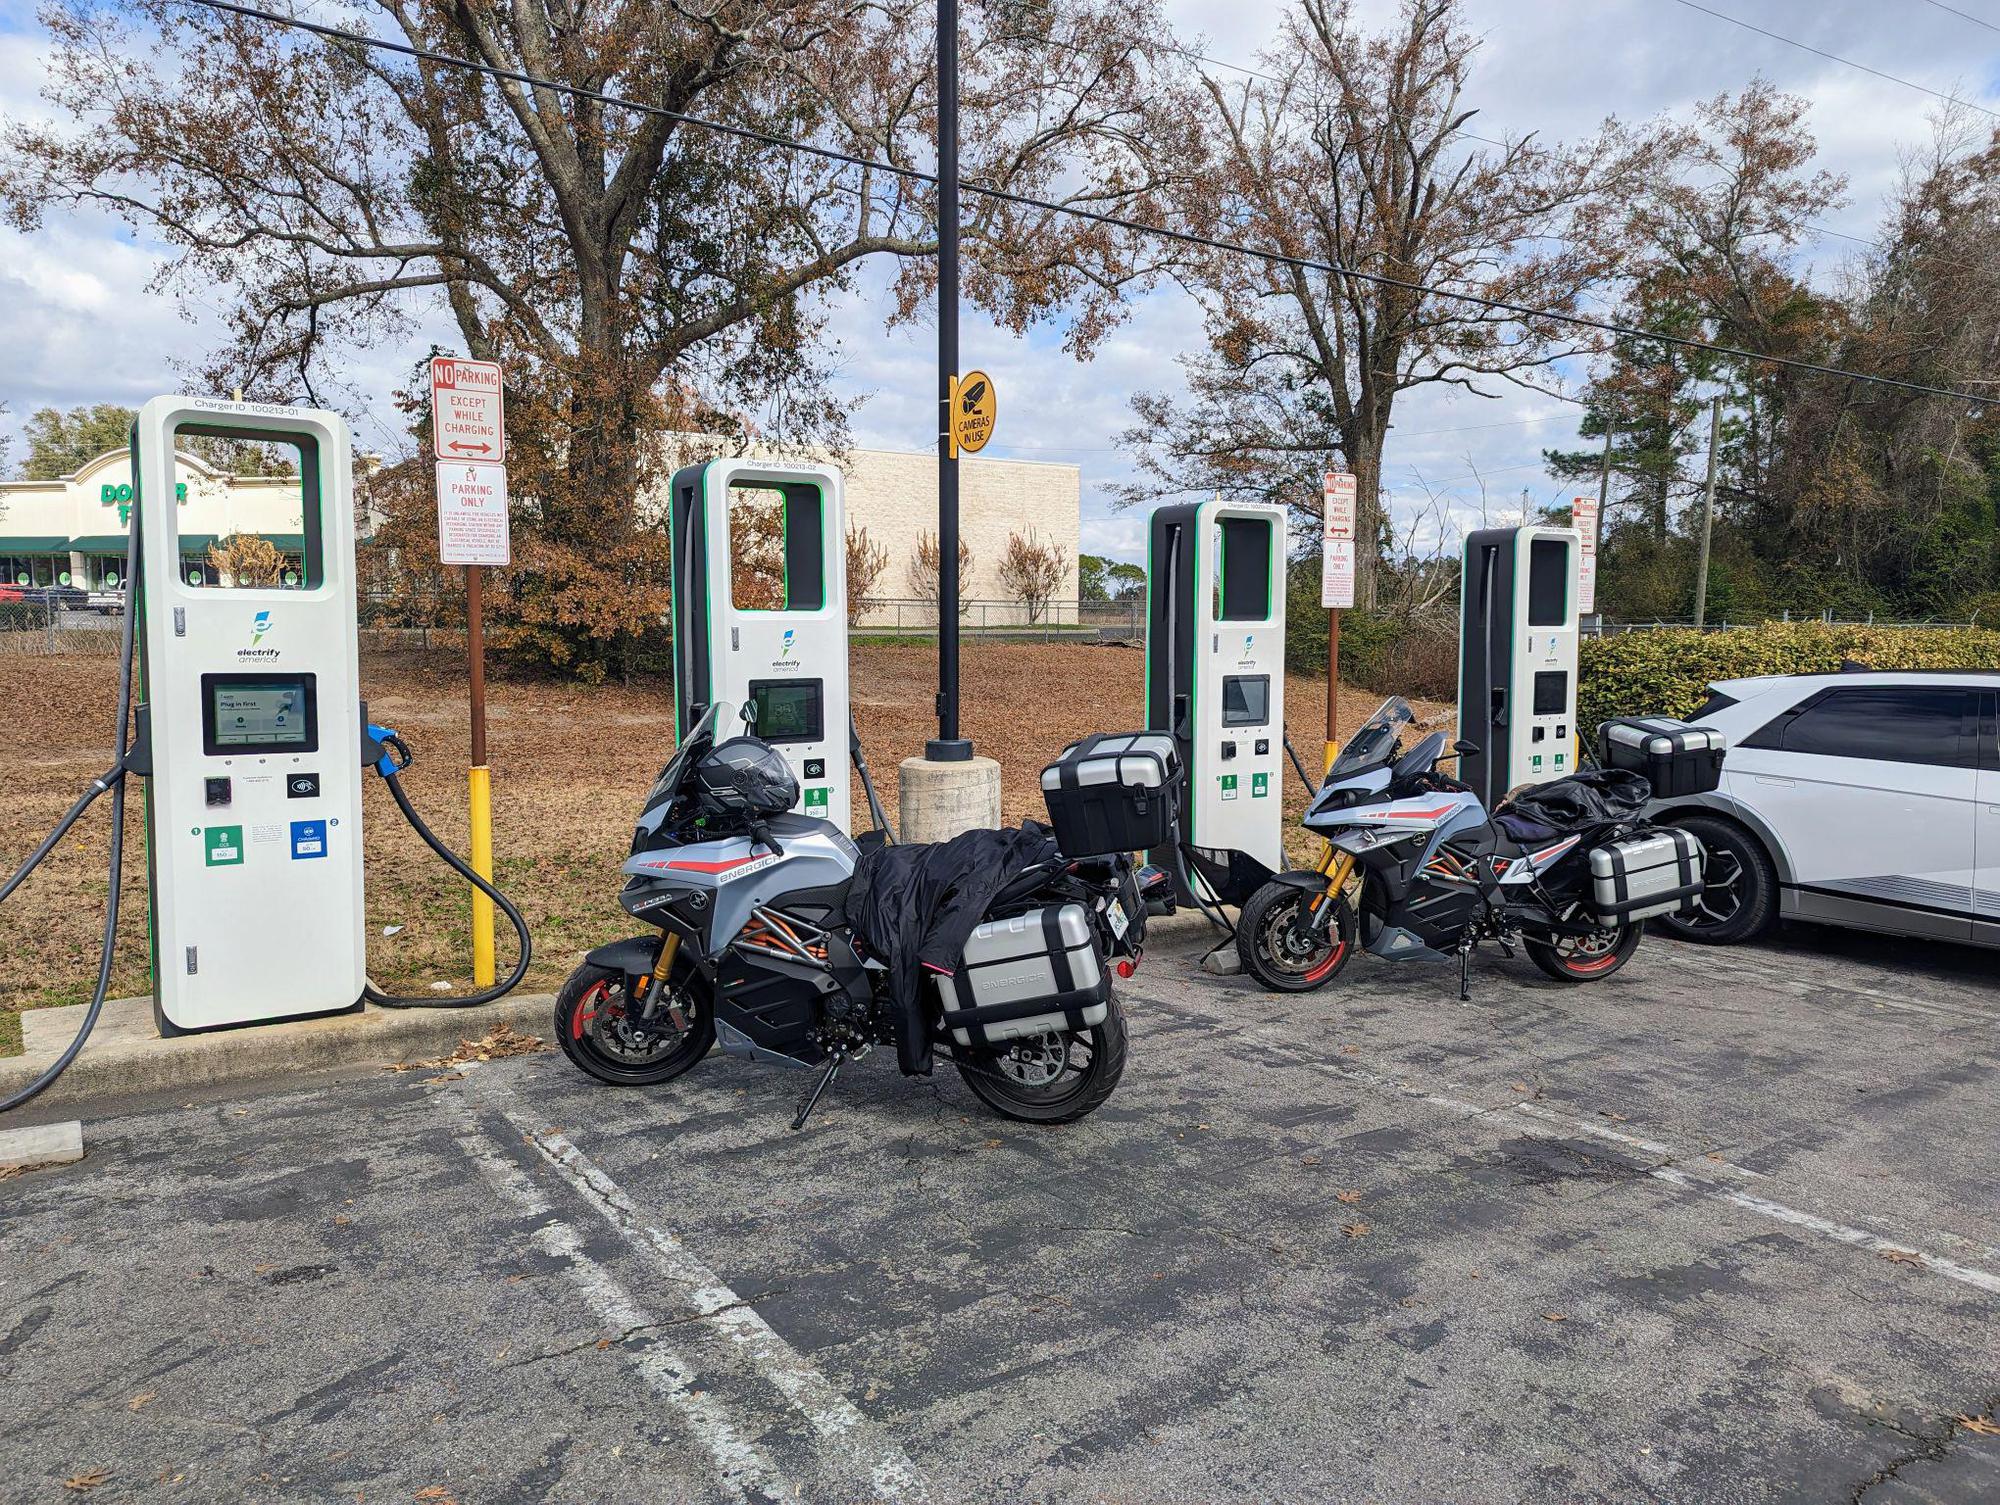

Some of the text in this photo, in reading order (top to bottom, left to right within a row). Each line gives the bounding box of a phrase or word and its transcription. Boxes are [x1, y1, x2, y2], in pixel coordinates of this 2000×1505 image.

[434, 364, 497, 386] NO PARKING
[194, 399, 299, 416] Charger ID 100213-01
[450, 395, 486, 409] EXCEPT
[454, 409, 484, 422] WHILE
[445, 422, 494, 436] CHARGING
[958, 415, 990, 432] CAMERAS
[964, 430, 984, 444] IN USE
[465, 471, 477, 482] EV
[452, 483, 493, 496] PARKING
[461, 496, 485, 508] ONLY
[237, 648, 280, 658] electrify
[771, 660, 801, 668] electrify
